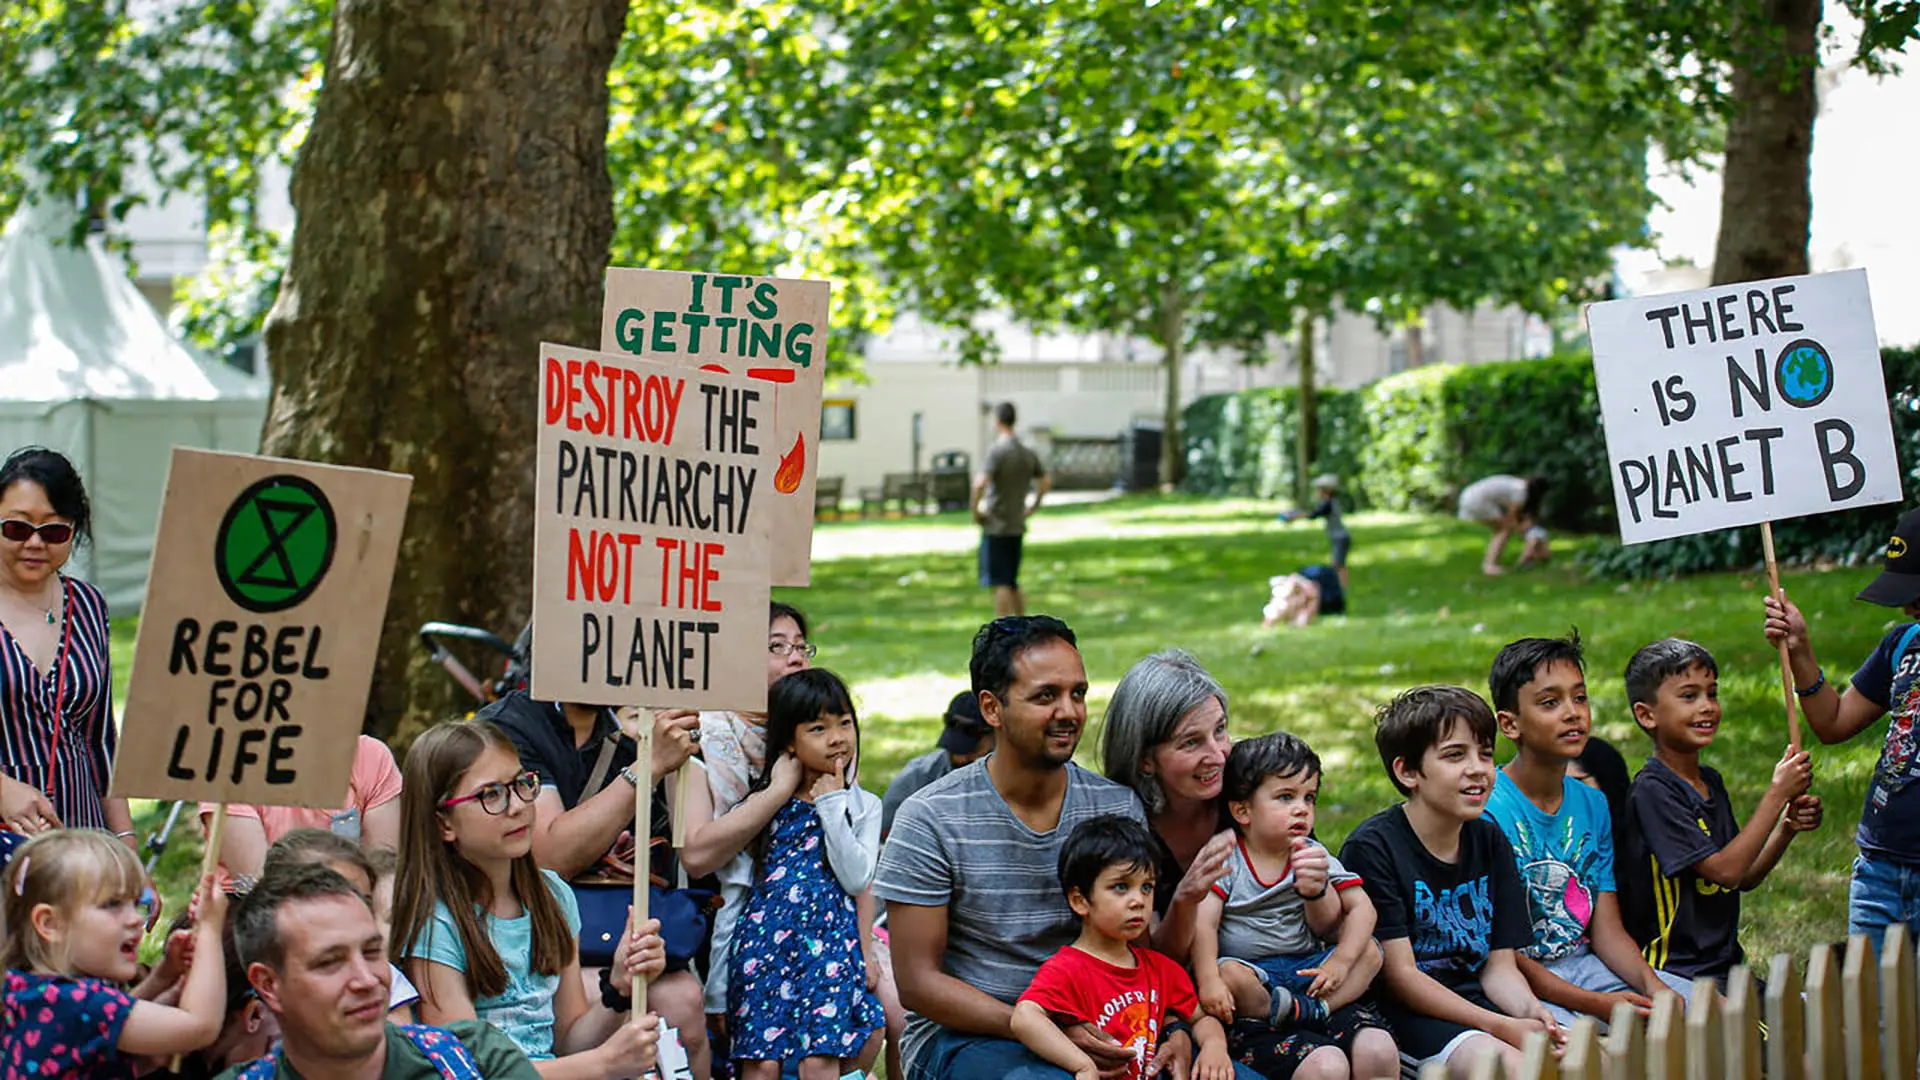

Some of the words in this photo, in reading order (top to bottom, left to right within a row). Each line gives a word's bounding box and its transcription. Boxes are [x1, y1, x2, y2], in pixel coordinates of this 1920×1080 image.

[689, 274, 778, 319] IT'S
[1645, 284, 1804, 349] THERE
[615, 309, 814, 368] GETTING
[545, 357, 685, 446] DESTROY
[700, 383, 760, 455] THE
[1652, 375, 1696, 426] IS
[1726, 338, 1834, 418] NO
[557, 440, 757, 535] PATRIARCHY
[1619, 427, 1784, 524] PLANET
[1814, 418, 1866, 501] B
[567, 528, 641, 603] NOT
[656, 537, 725, 612] THE
[168, 618, 330, 680] REBEL
[581, 612, 720, 691] PLANET
[207, 678, 292, 725] FOR
[167, 725, 303, 785] LIFE
